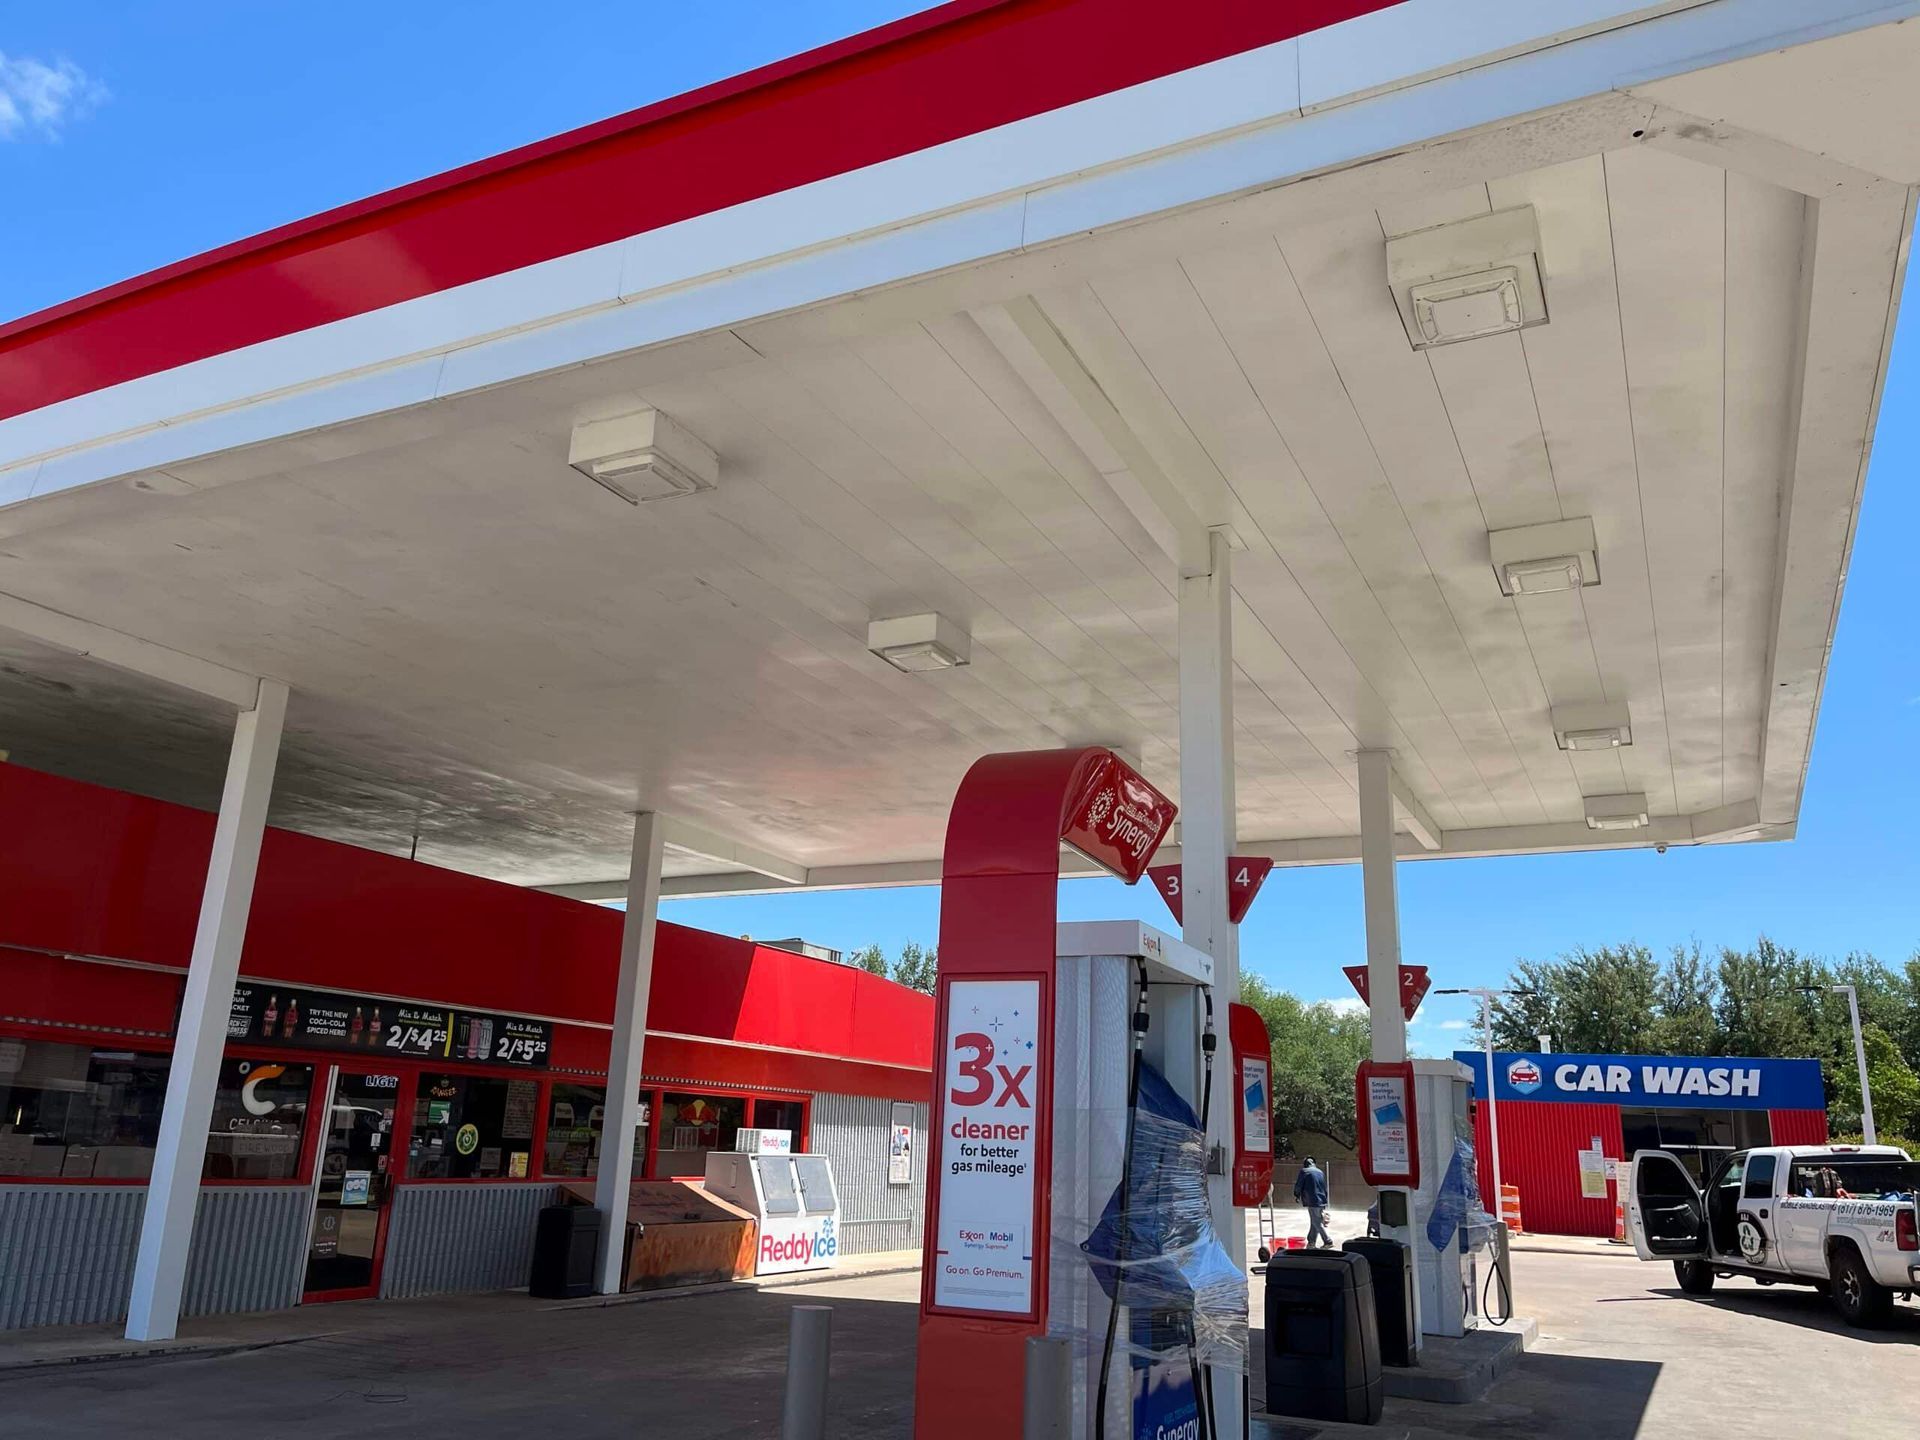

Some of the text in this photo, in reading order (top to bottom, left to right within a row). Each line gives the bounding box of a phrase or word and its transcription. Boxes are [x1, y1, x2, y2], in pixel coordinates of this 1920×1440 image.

[1107, 805, 1153, 860] Synergy
[1235, 867, 1250, 887] 4
[1167, 876, 1180, 896] 3
[1356, 974, 1364, 987] 1
[1404, 973, 1413, 986] 2
[309, 1008, 349, 1019] TRY THE NEW
[422, 1011, 442, 1022] Match
[309, 1017, 346, 1028] COCA-COLA
[306, 1026, 329, 1035] SPICED
[951, 1032, 1032, 1108] 3x
[365, 1075, 397, 1088] LIGH
[1554, 1063, 1761, 1097] CAR WASH
[951, 1116, 1029, 1141] cleaner
[960, 1143, 1019, 1159] for better
[951, 1161, 972, 1175] gas
[959, 1230, 1013, 1242] Exxon Mobil
[945, 1265, 957, 1274] Go
[972, 1267, 984, 1276] Go
[986, 1268, 1024, 1279] Premium.
